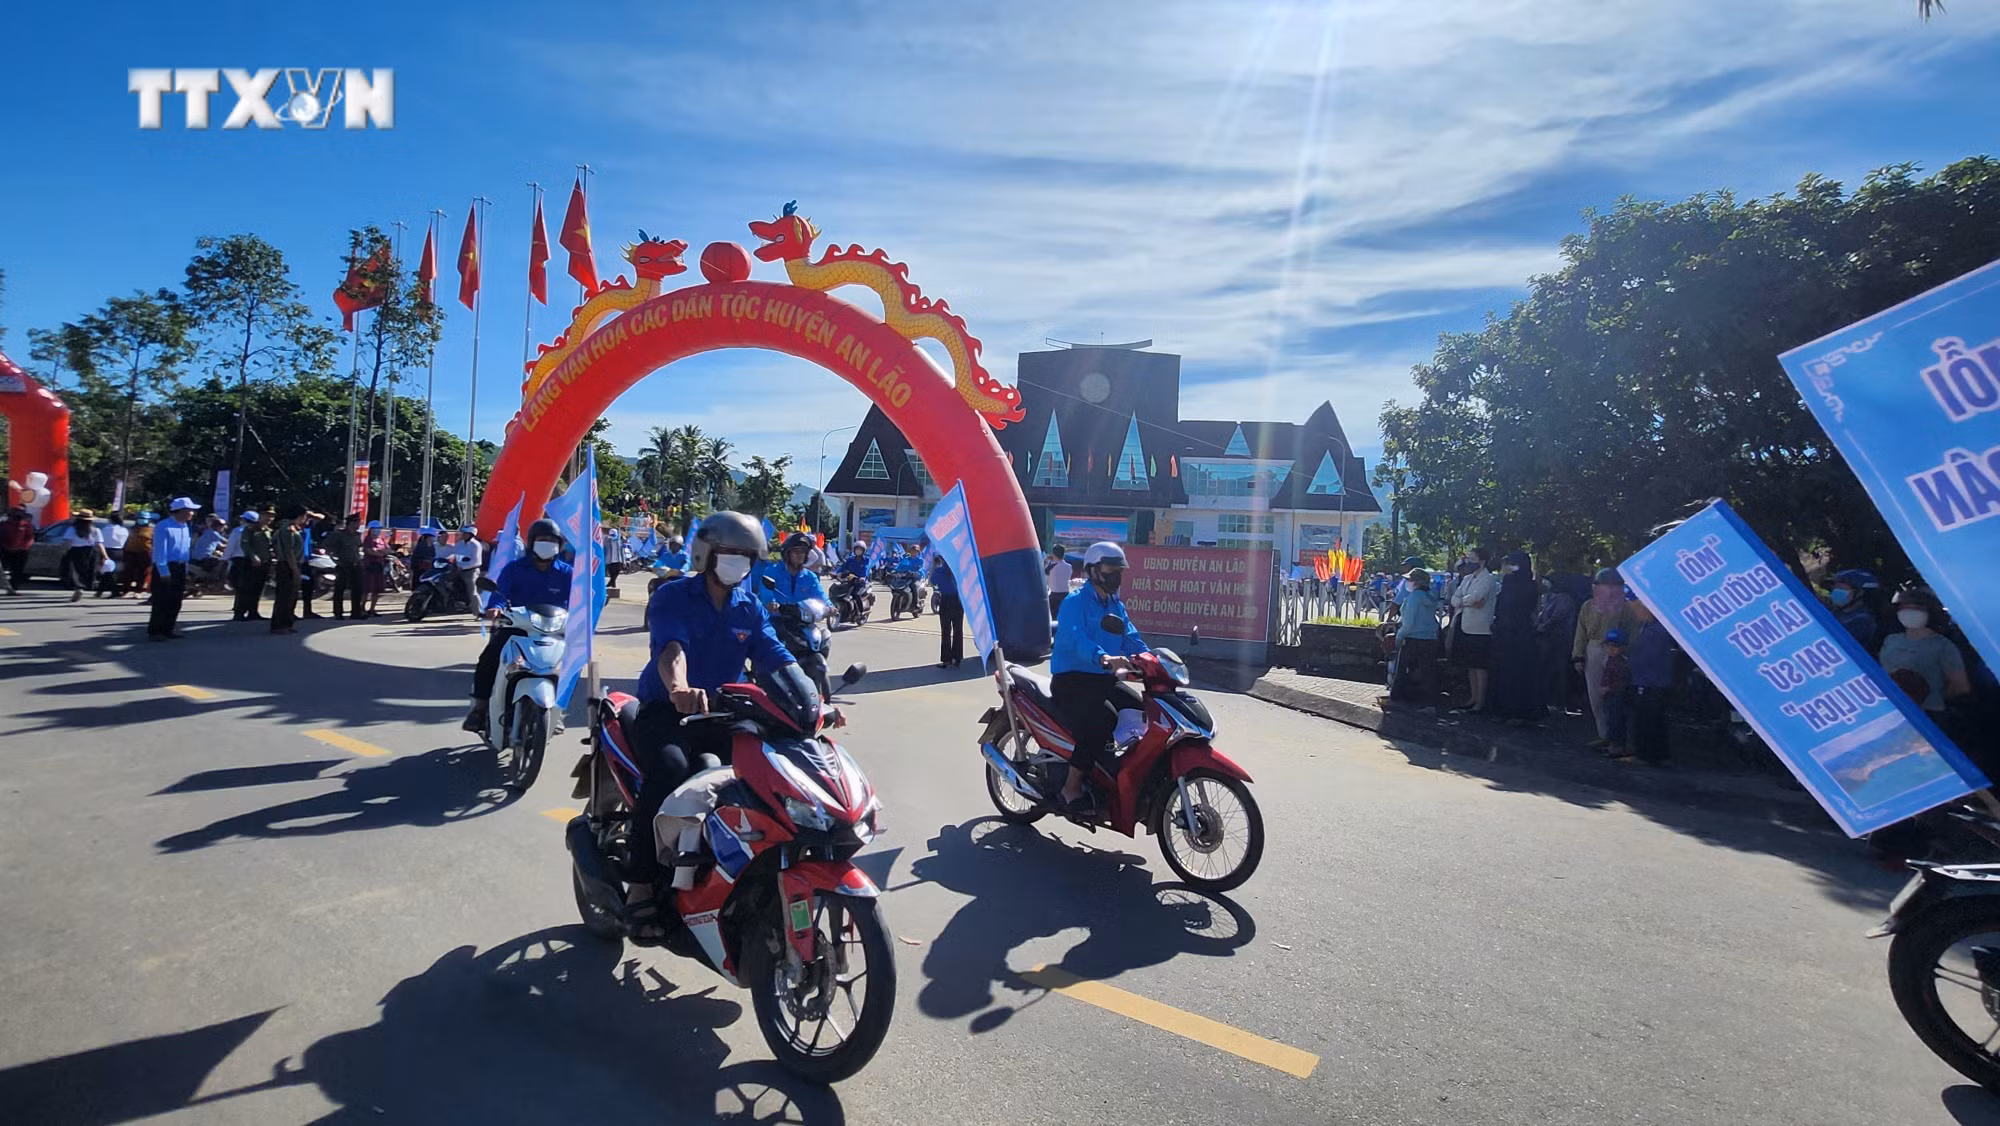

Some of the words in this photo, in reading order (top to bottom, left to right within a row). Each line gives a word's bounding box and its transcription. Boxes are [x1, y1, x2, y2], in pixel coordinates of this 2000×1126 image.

[672, 292, 714, 323] DÂN
[720, 290, 761, 323] TỘC
[763, 298, 838, 349] HUYỆN
[835, 335, 871, 371] AN
[866, 356, 912, 408] LÃO
[1143, 557, 1170, 570] UBND
[1172, 555, 1206, 573] HUYỆN
[1209, 560, 1223, 572] AN
[1226, 558, 1246, 574] LÃO
[1132, 576, 1151, 591] NHÀ
[1154, 579, 1177, 592] SINH
[1180, 580, 1207, 596] HOẠT
[1126, 597, 1151, 612] CÔNG
[1183, 600, 1220, 618] HUYỆN
[1221, 604, 1235, 618] AN
